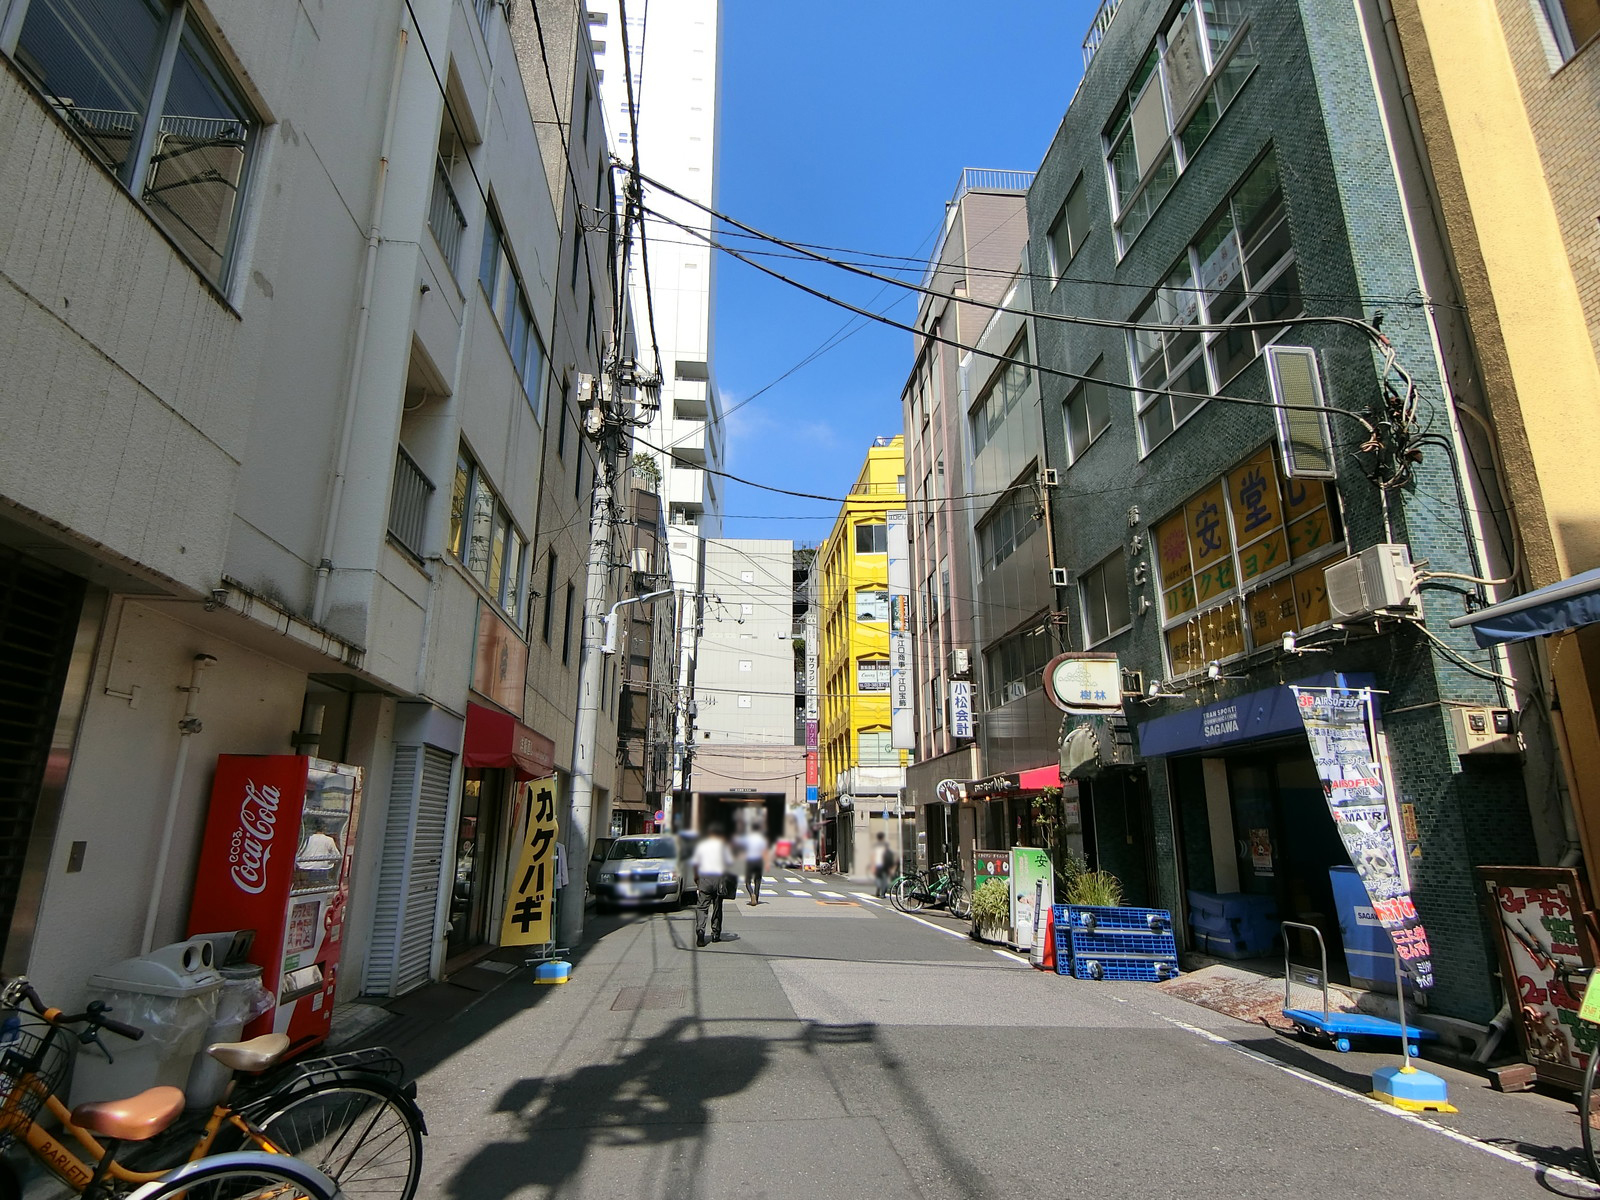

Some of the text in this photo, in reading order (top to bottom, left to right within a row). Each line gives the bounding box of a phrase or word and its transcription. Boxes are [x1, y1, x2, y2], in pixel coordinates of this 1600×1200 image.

[1080, 689, 1107, 700] 樹林
[1299, 695, 1360, 707] 3F AIRSOFT97
[954, 683, 969, 735] 小松会計
[1204, 720, 1239, 737] SAGAWA
[939, 780, 957, 792] WINE
[231, 777, 281, 895] Coca-Cola
[39, 1141, 89, 1185] BARLETT
